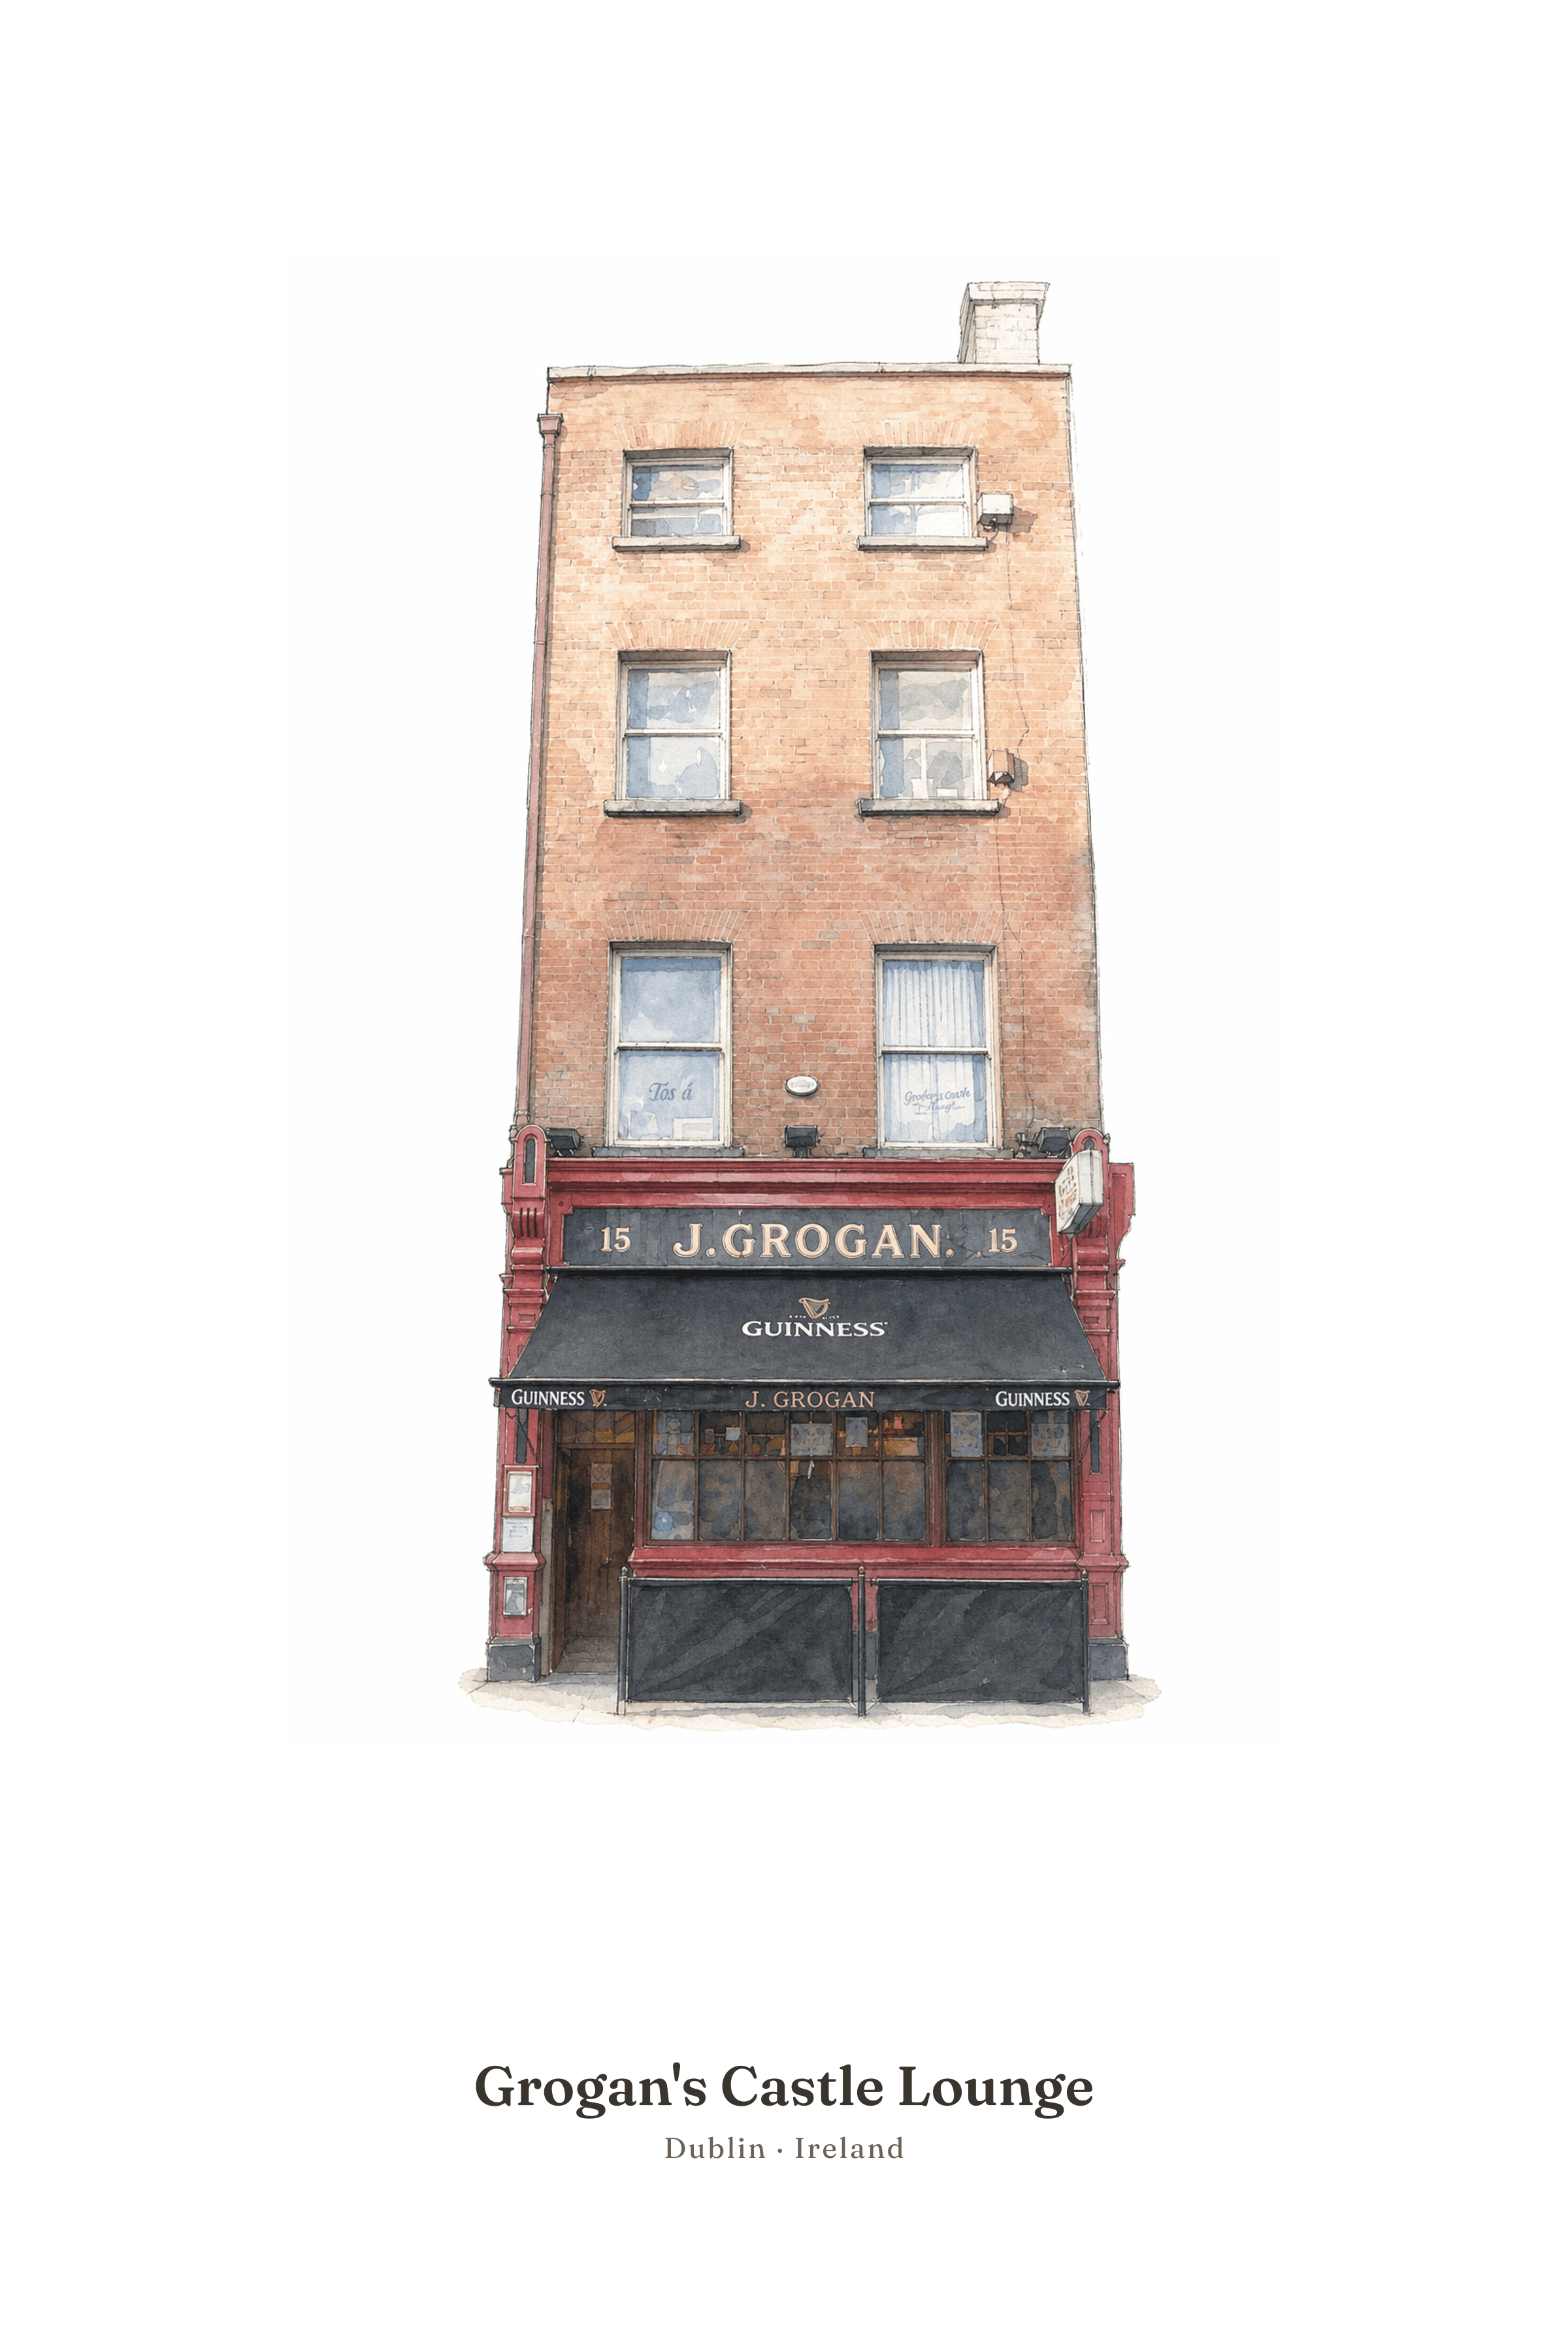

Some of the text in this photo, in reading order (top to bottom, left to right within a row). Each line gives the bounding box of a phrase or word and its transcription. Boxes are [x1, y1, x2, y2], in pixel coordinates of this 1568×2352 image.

[649, 1082, 676, 1101] Tos
[600, 1226, 632, 1252] 15
[988, 1228, 1018, 1253] 15
[742, 1320, 889, 1337] GUINNESS
[511, 1388, 585, 1406] GUINNESS
[745, 1391, 875, 1409] J. GROGAN
[995, 1390, 1070, 1407] GUINNESS
